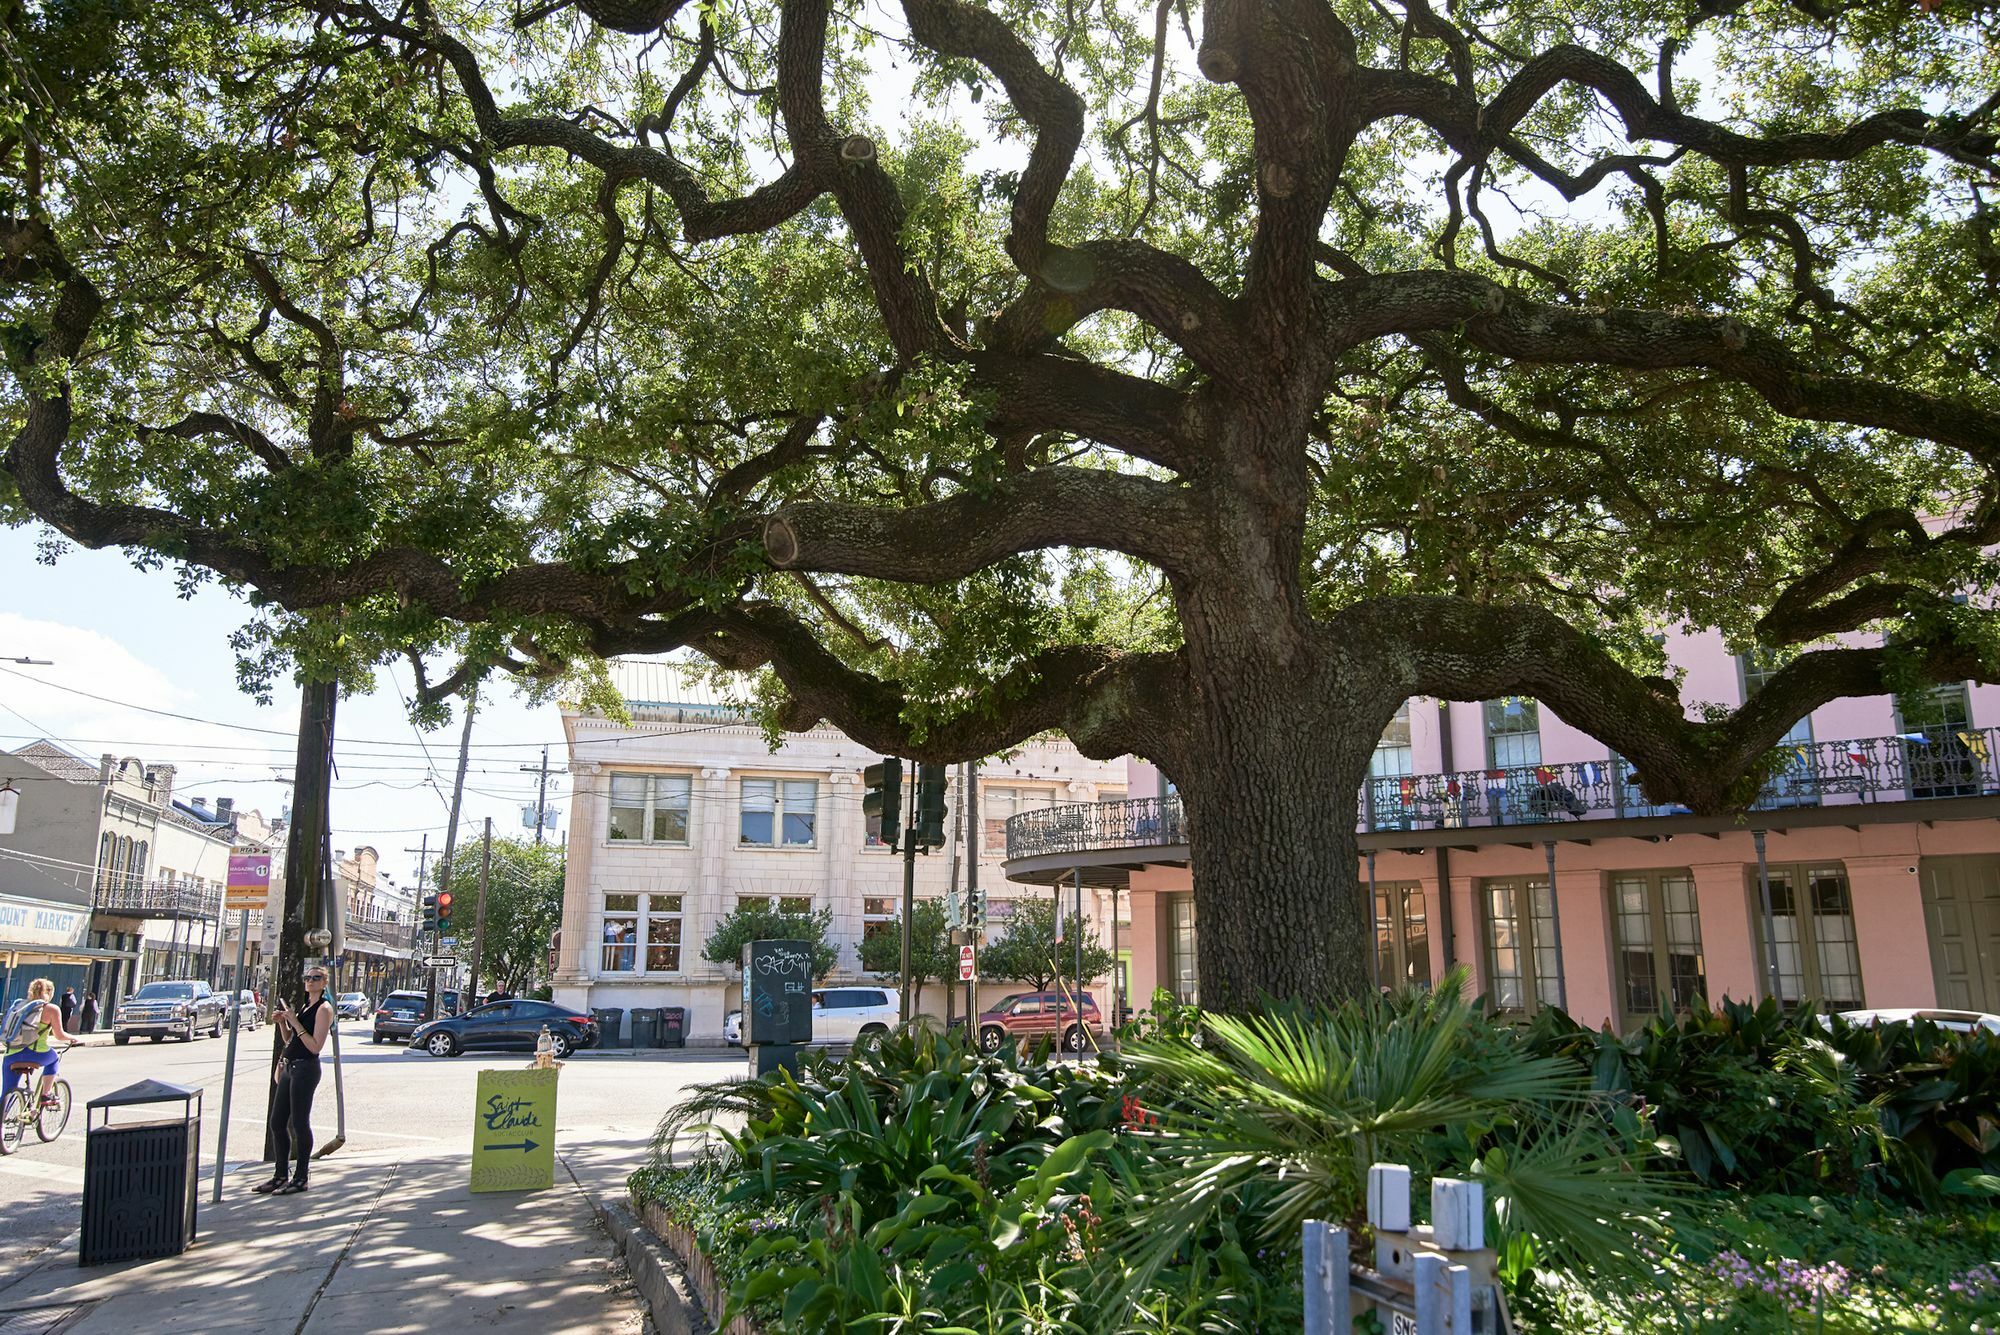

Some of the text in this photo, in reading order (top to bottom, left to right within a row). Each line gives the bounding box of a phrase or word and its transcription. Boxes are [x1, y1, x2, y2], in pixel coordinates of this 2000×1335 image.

[35, 911, 74, 932] MARKET
[483, 1094, 536, 1118] Saint
[487, 1110, 542, 1131] Claude
